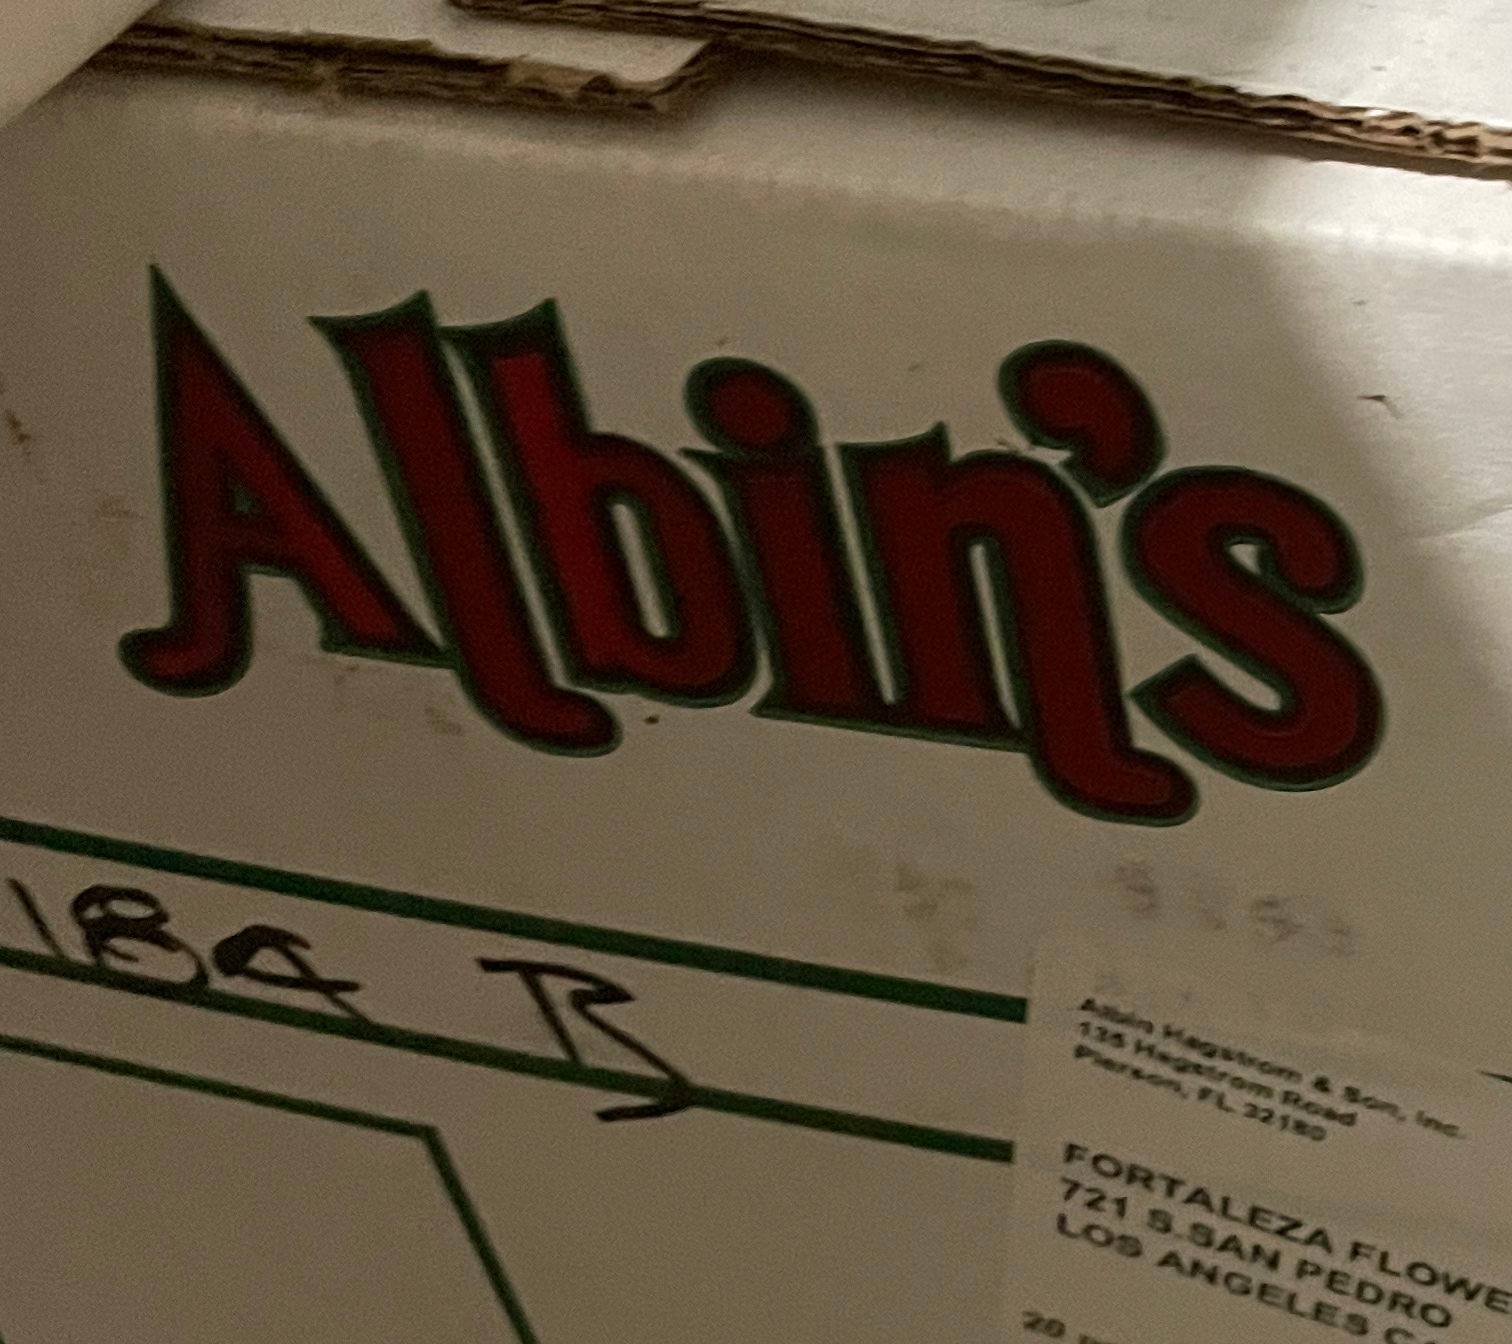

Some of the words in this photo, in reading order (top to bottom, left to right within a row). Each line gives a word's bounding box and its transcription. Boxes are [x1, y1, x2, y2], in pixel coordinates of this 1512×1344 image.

[118, 262, 1386, 827] Albin's
[1197, 1085, 1236, 1114] FL
[1280, 1089, 1359, 1128] Road
[1313, 1075, 1333, 1095] &
[1060, 1176, 1129, 1220] 721
[1295, 1258, 1454, 1330] PEDRO
[1064, 1141, 1336, 1254] FORTALEZA
[1055, 1212, 1145, 1258] LOS
[1156, 1250, 1372, 1338] ANGELES
